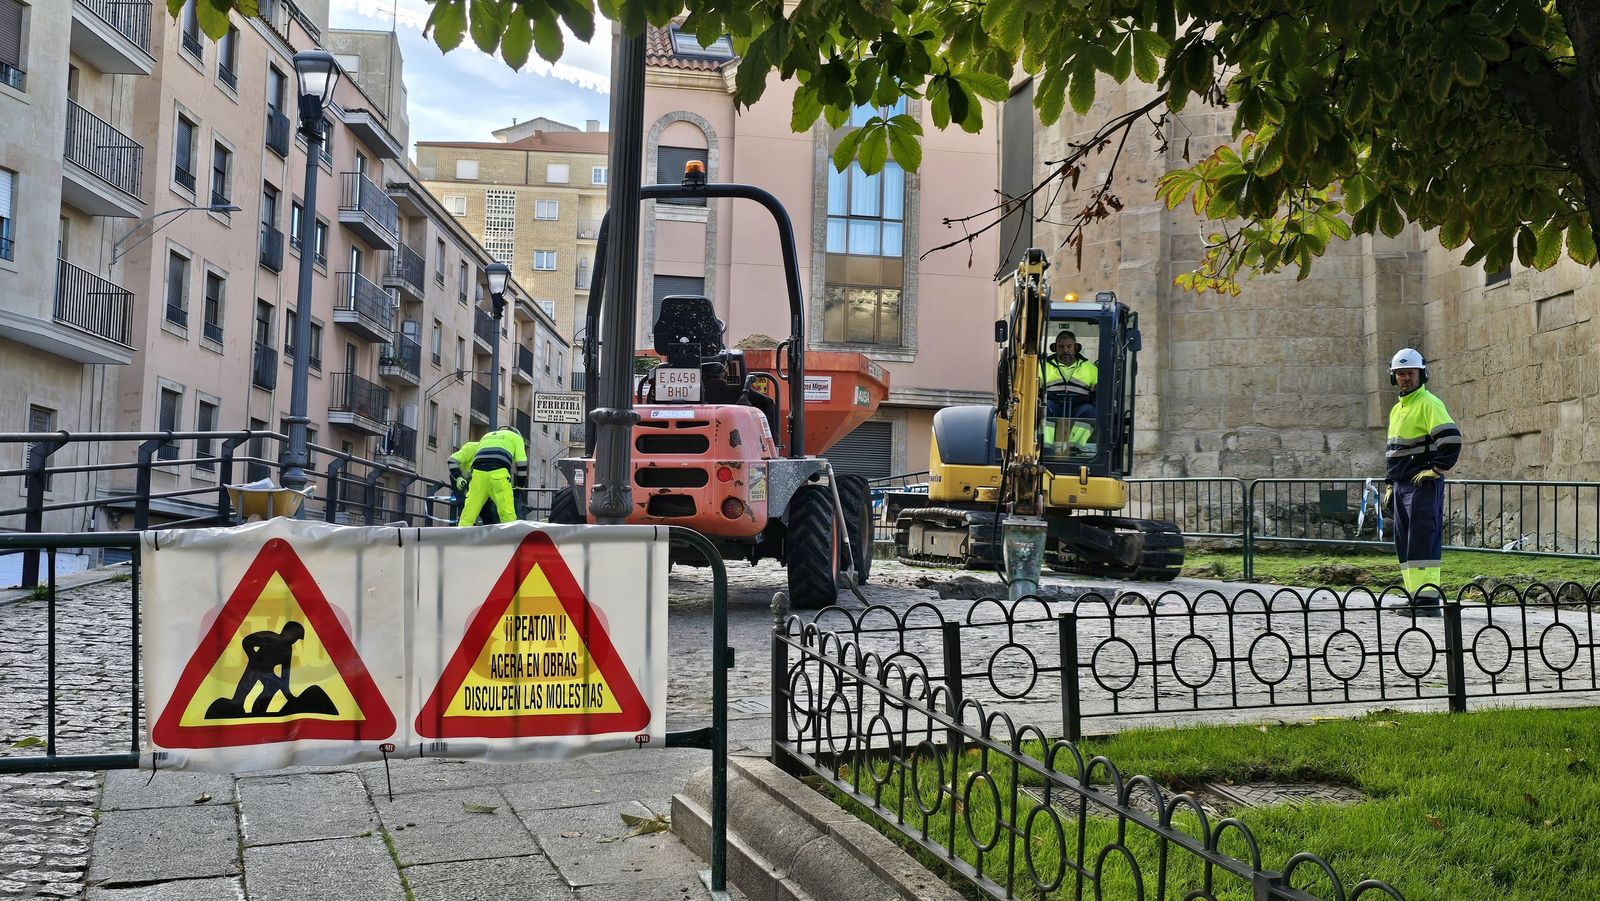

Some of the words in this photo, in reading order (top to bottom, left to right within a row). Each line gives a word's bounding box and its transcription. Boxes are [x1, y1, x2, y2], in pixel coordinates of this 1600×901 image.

[668, 386, 689, 397] BHD
[537, 401, 580, 410] FERREIRA
[490, 654, 524, 679] ACERA
[526, 653, 540, 678] EN
[543, 652, 577, 677] OBRAS
[464, 686, 521, 711] DISCULPEN
[524, 684, 542, 710] LAS
[546, 683, 603, 709] MOLESTIAS
